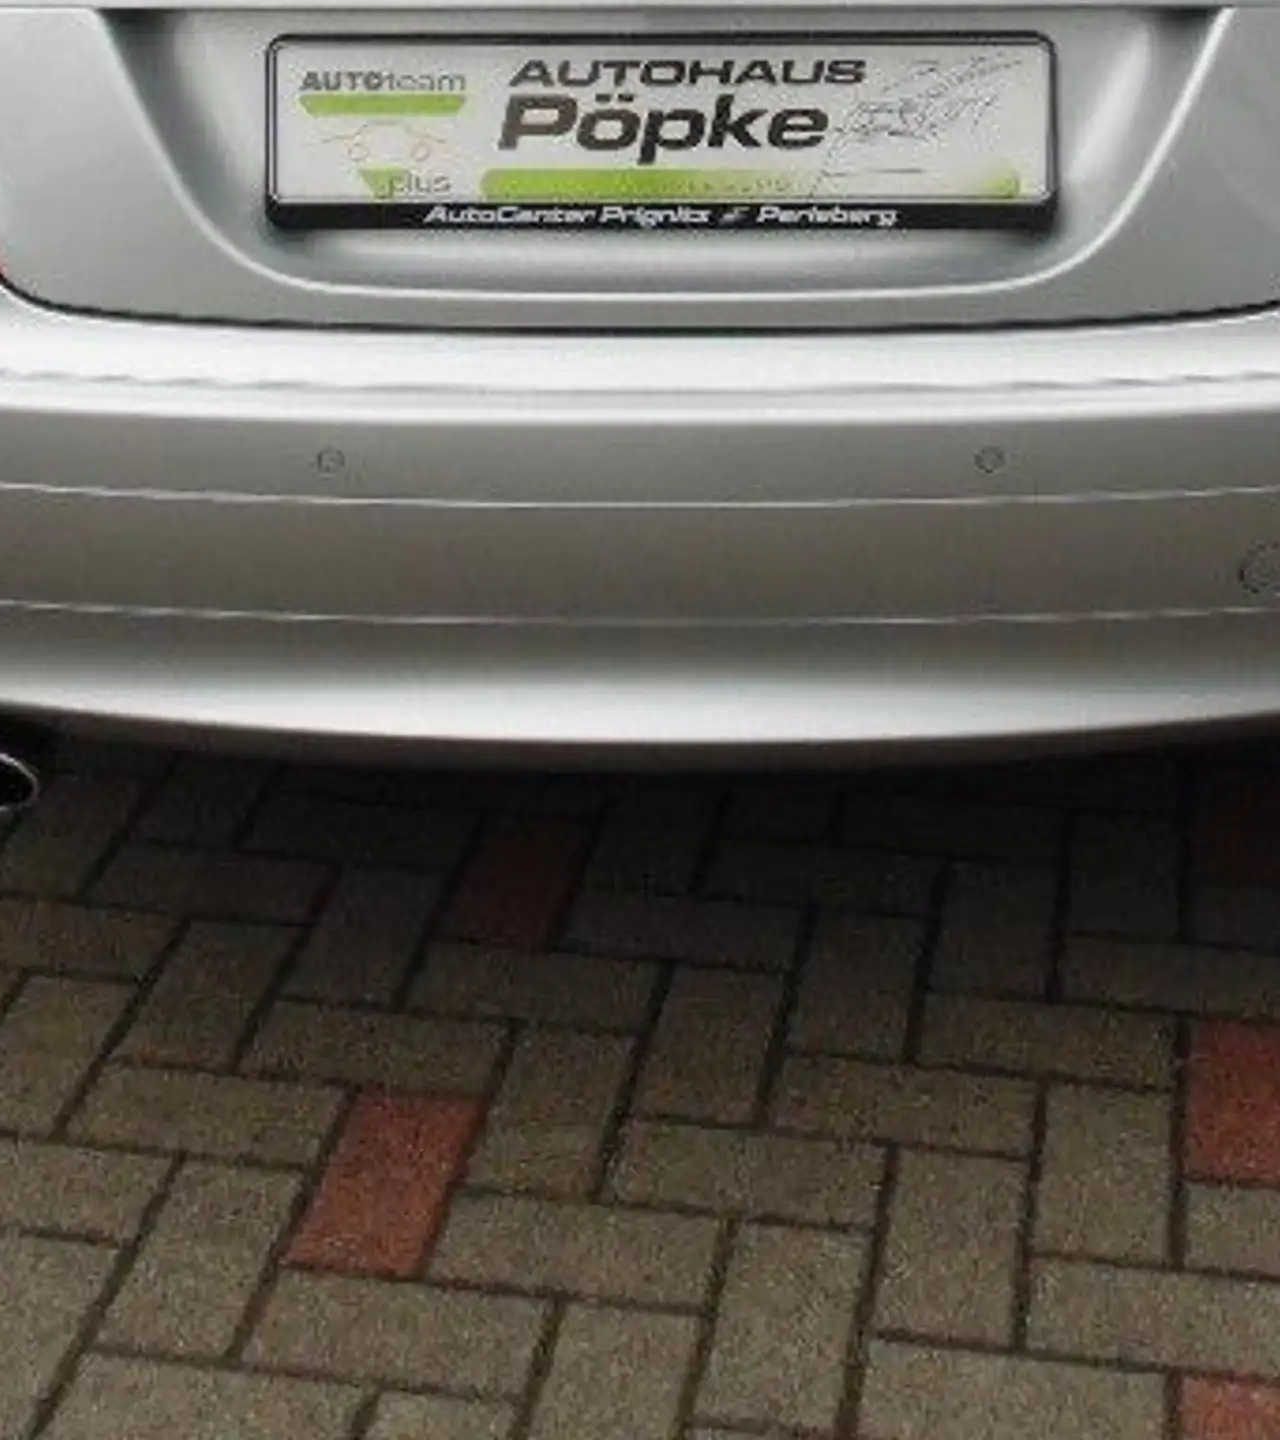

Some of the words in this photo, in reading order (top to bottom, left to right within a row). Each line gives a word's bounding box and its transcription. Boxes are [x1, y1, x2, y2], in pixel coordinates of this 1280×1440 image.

[508, 59, 866, 88] AUTOHAUS
[497, 92, 829, 166] Pöpke
[423, 205, 598, 224] AutoCenter
